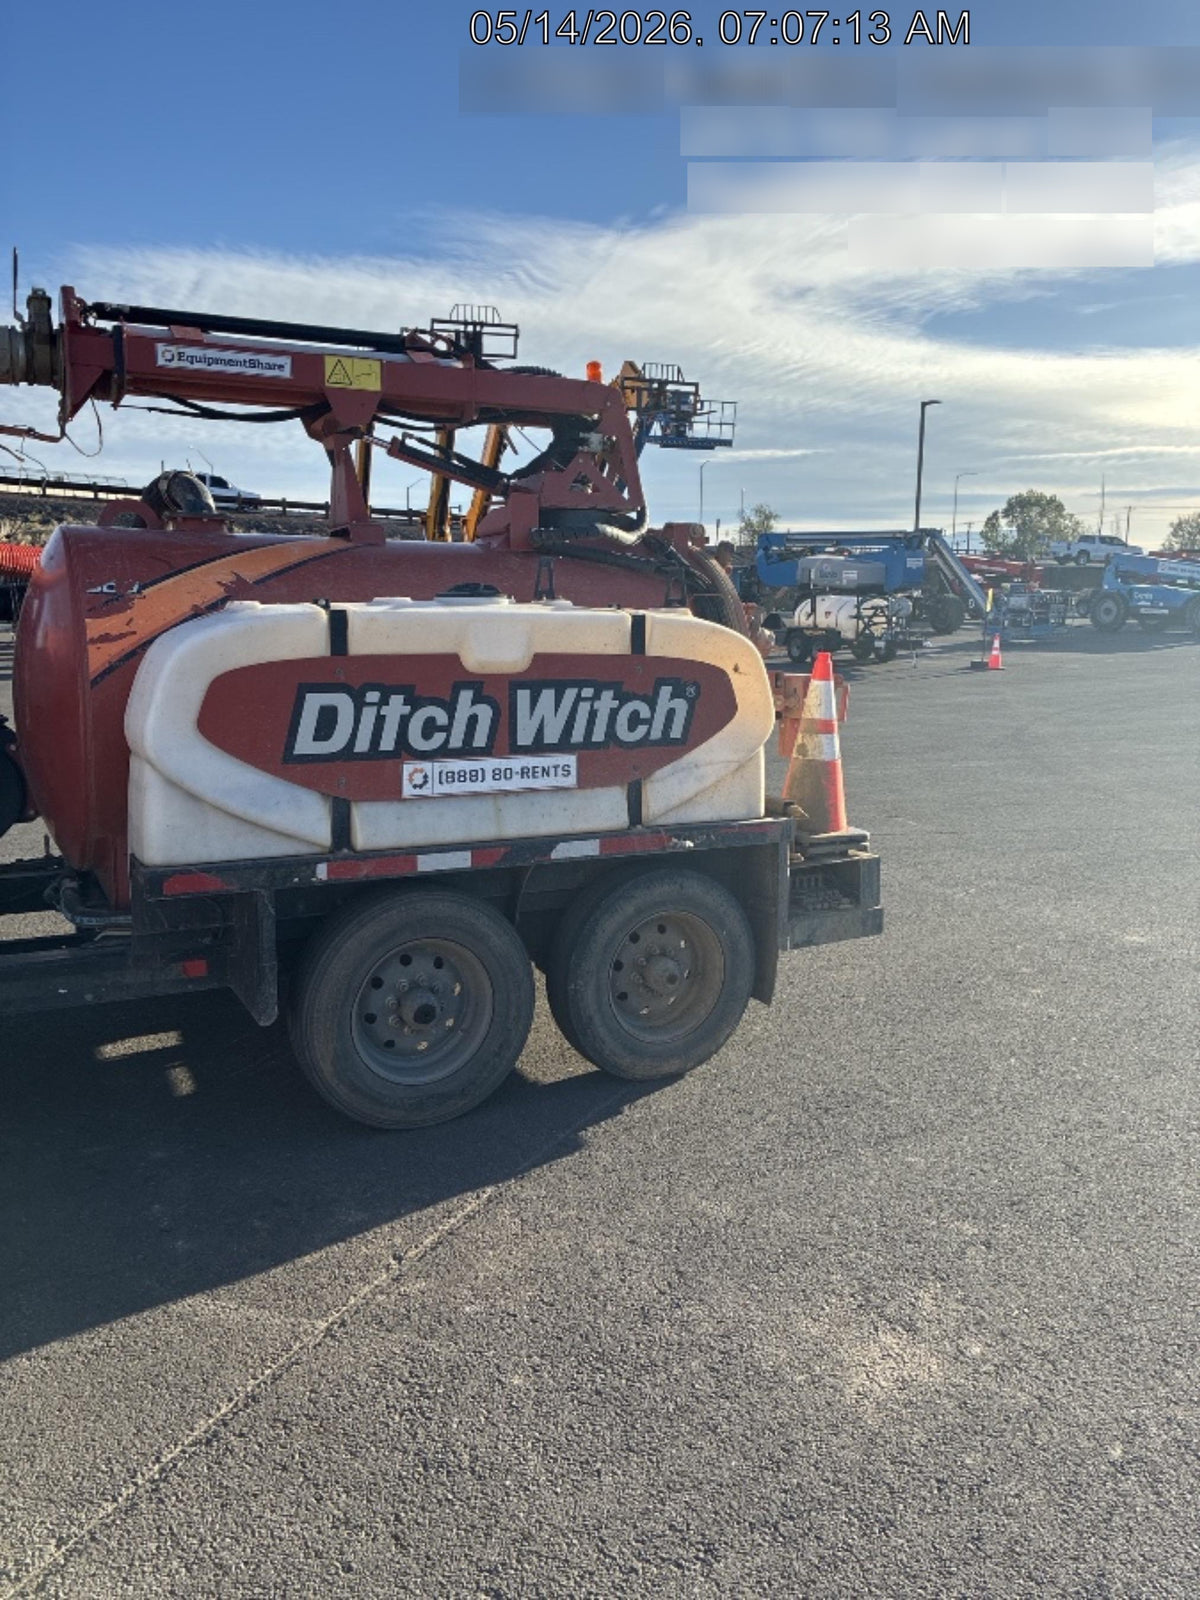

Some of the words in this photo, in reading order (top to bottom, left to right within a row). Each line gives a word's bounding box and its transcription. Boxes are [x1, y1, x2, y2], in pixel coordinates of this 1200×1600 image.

[177, 351, 286, 372] EquipmentShare
[292, 689, 493, 755] Ditch
[438, 767, 486, 785] (888)
[492, 764, 572, 781] 80-RENTS
